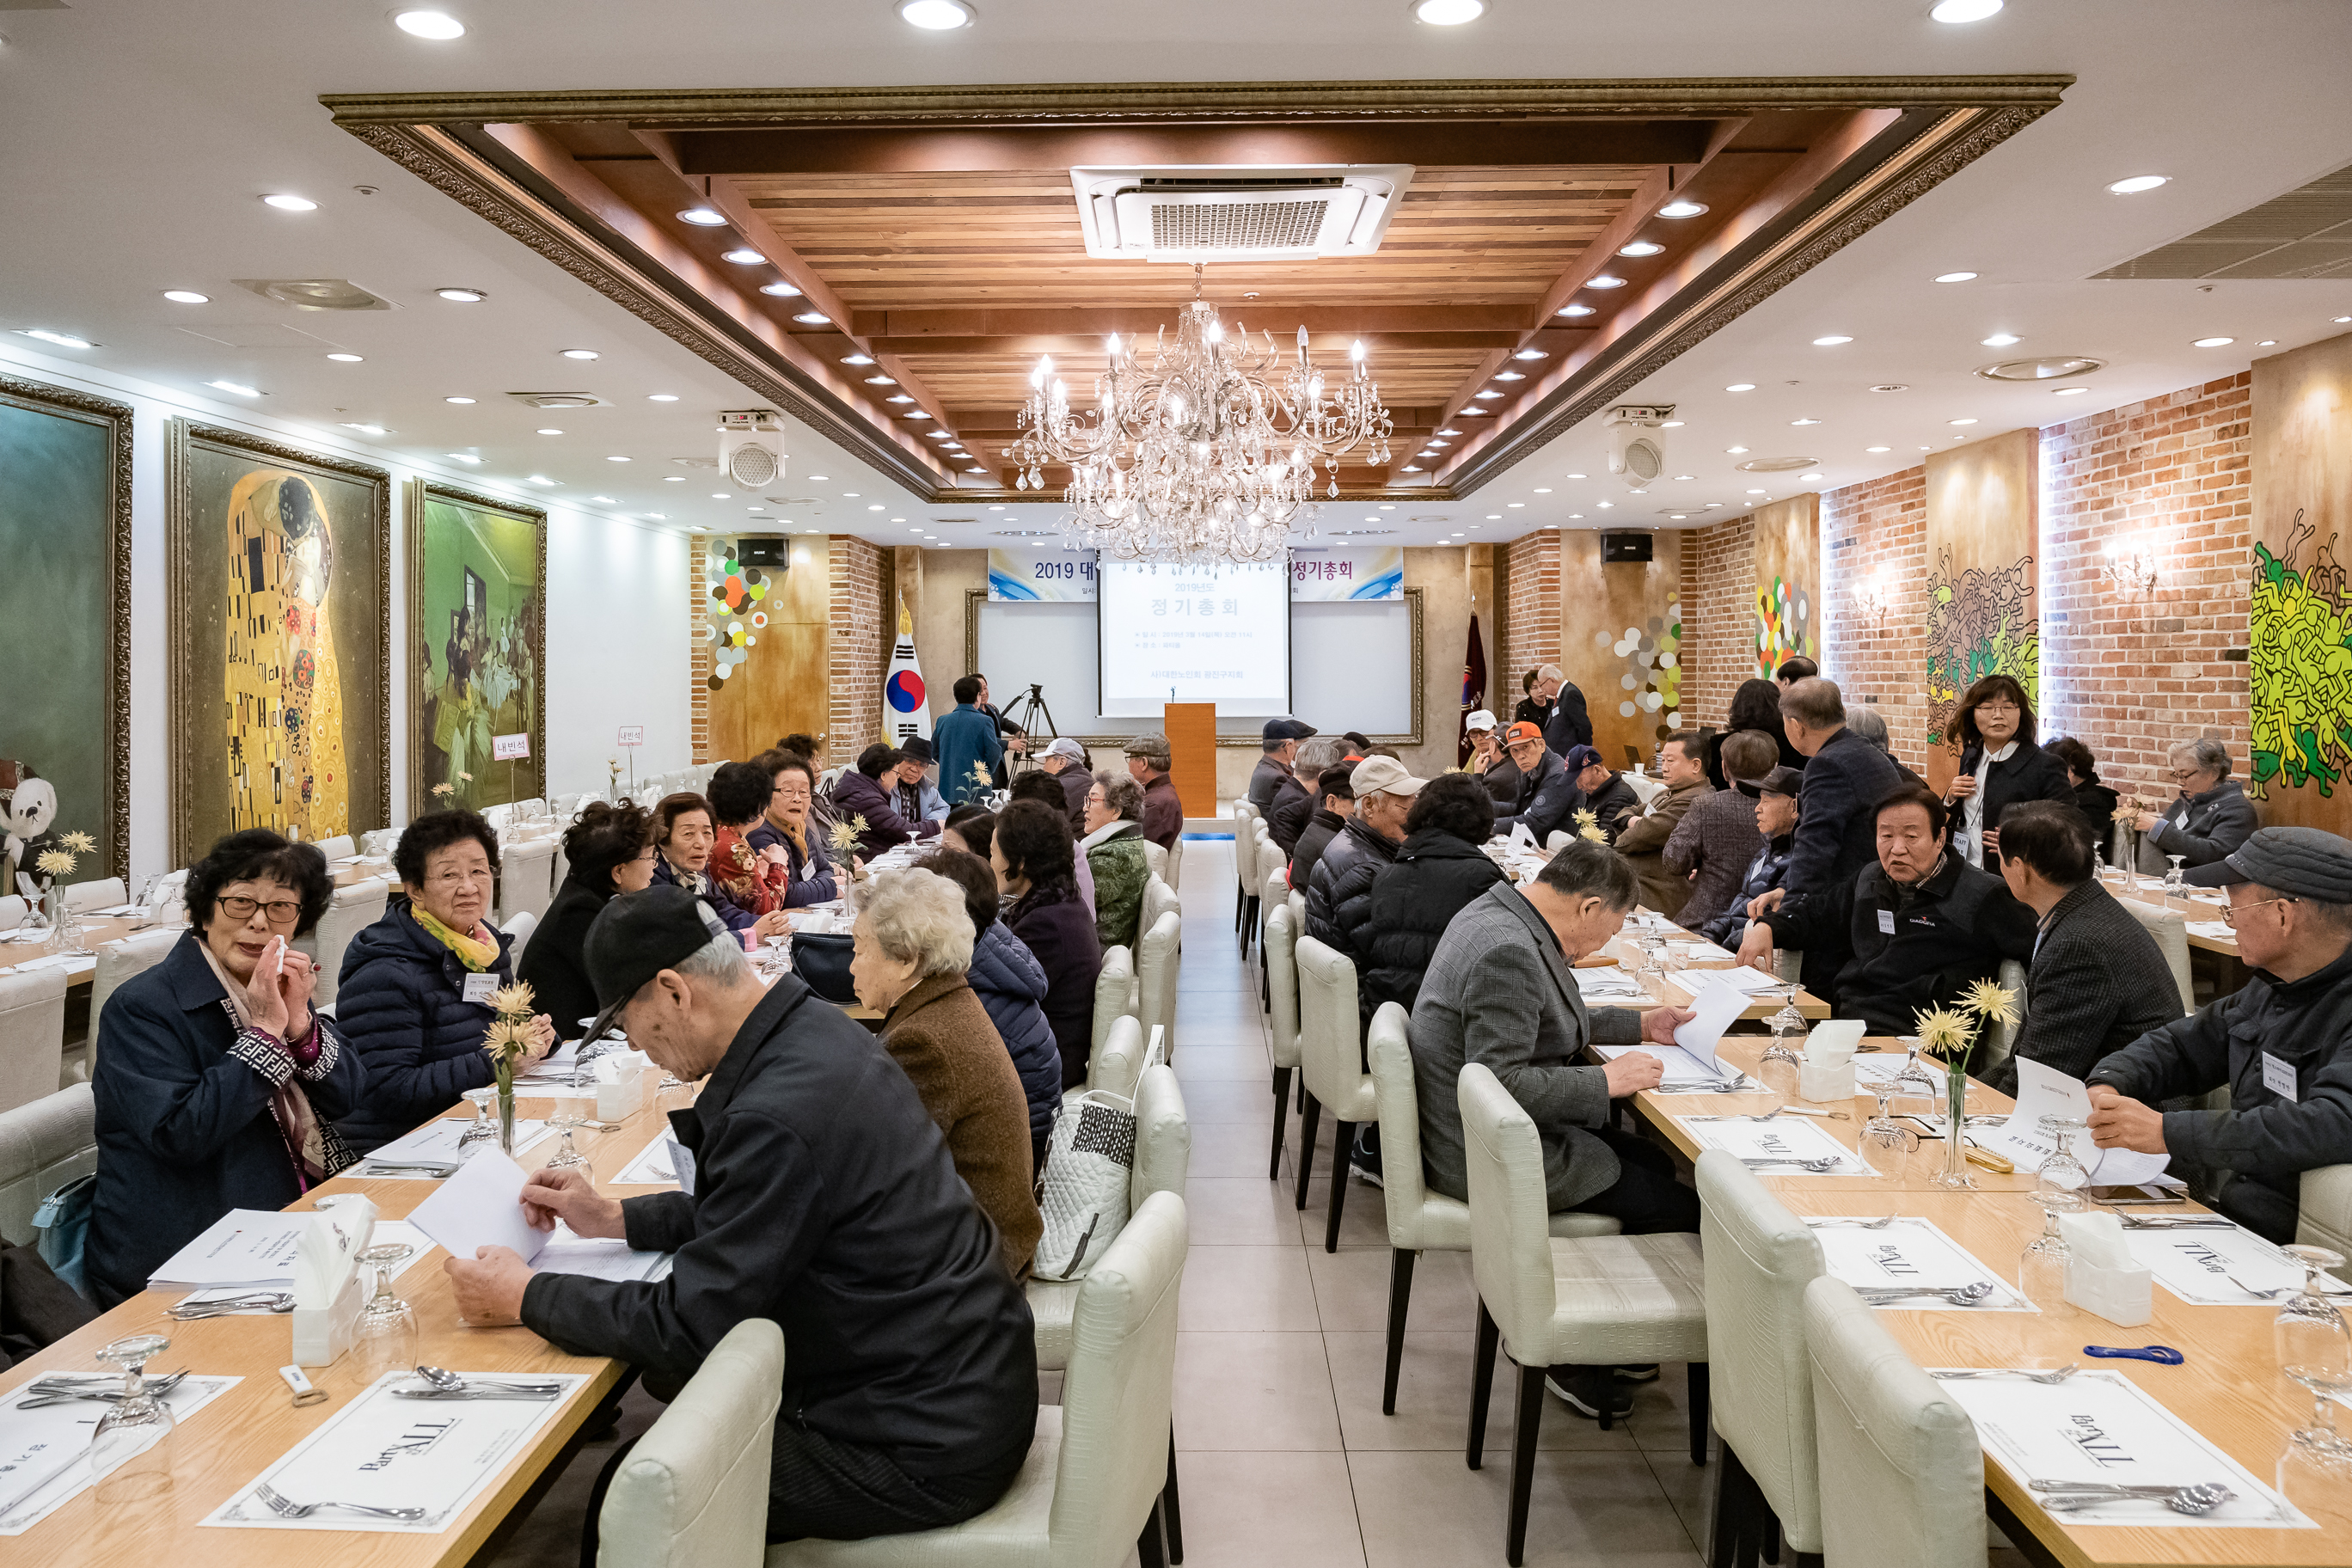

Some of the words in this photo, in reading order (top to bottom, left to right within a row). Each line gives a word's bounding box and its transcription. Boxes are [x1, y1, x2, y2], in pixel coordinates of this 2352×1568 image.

[1035, 562, 1074, 579] 2019
[1292, 560, 1352, 581] 정기총회
[1174, 582, 1216, 592] 2019년도
[1204, 671, 1243, 679] 광진구지회
[621, 732, 640, 740] 내빈석
[497, 740, 525, 753] 내빈석
